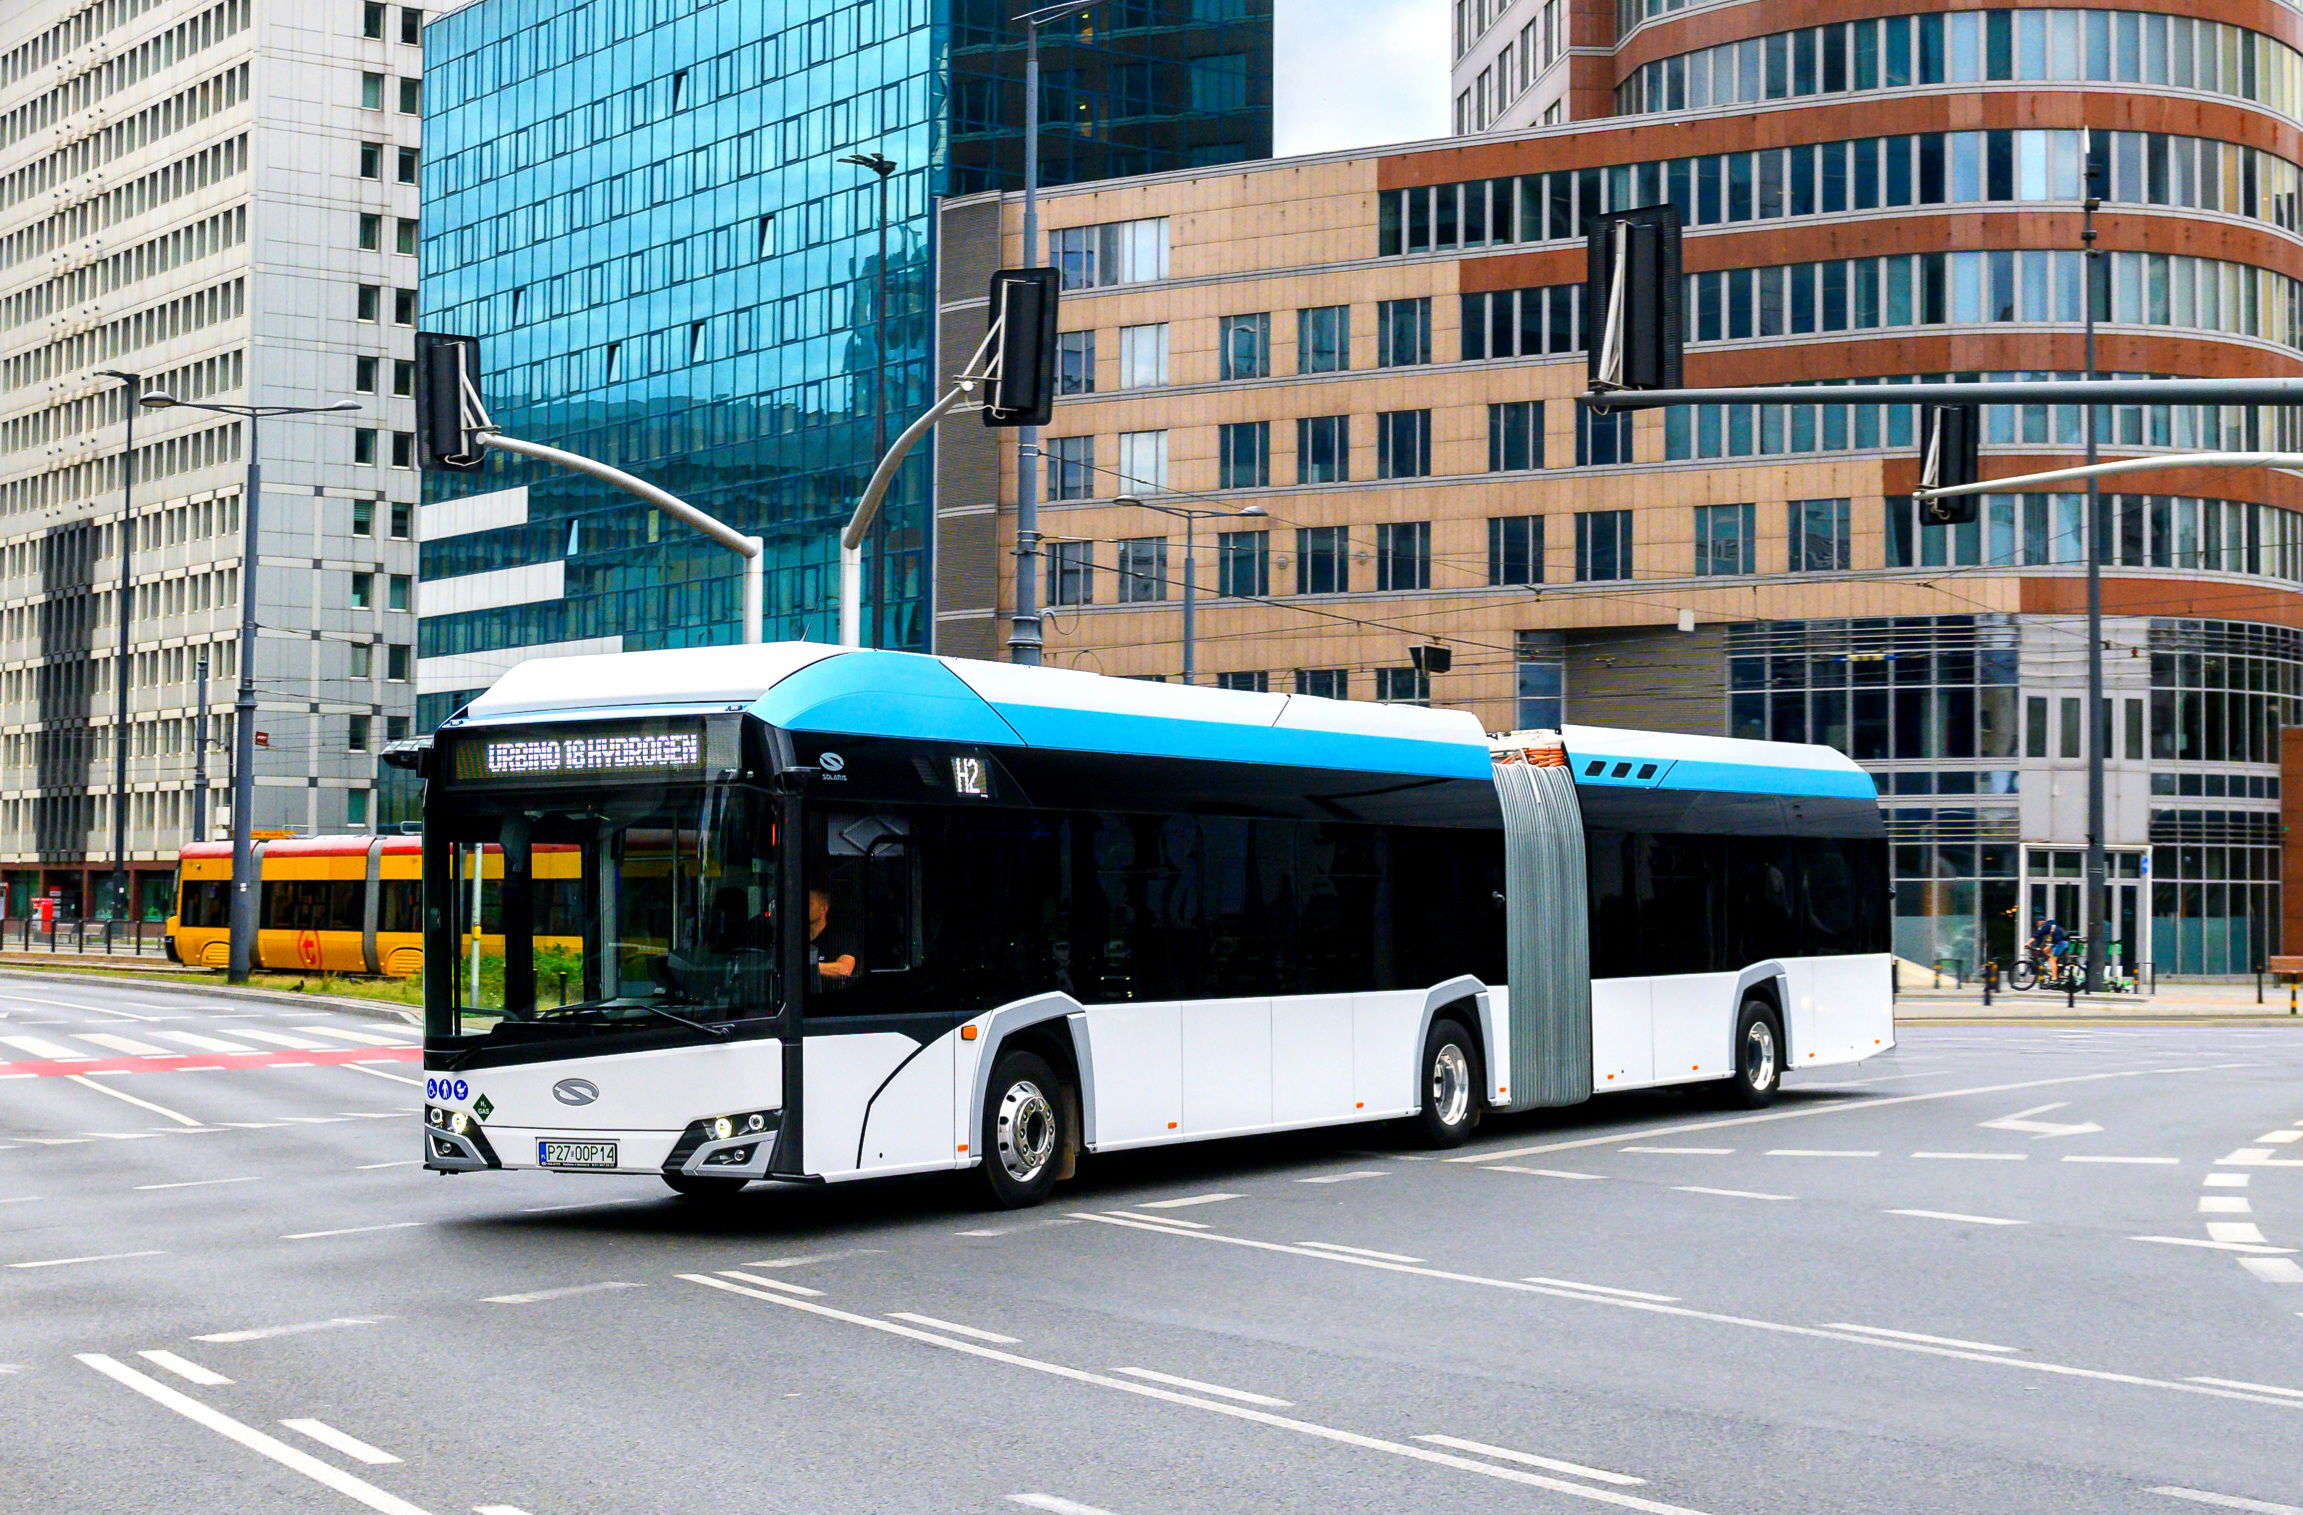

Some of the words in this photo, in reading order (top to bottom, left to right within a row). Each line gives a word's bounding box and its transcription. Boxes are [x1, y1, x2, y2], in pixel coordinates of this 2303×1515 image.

[488, 741, 561, 772] URBINO
[563, 739, 585, 768] 18
[587, 734, 698, 767] HYDROGEN
[822, 773, 848, 781] SOLARIS
[956, 758, 981, 793] H2
[477, 1107, 490, 1115] GAS
